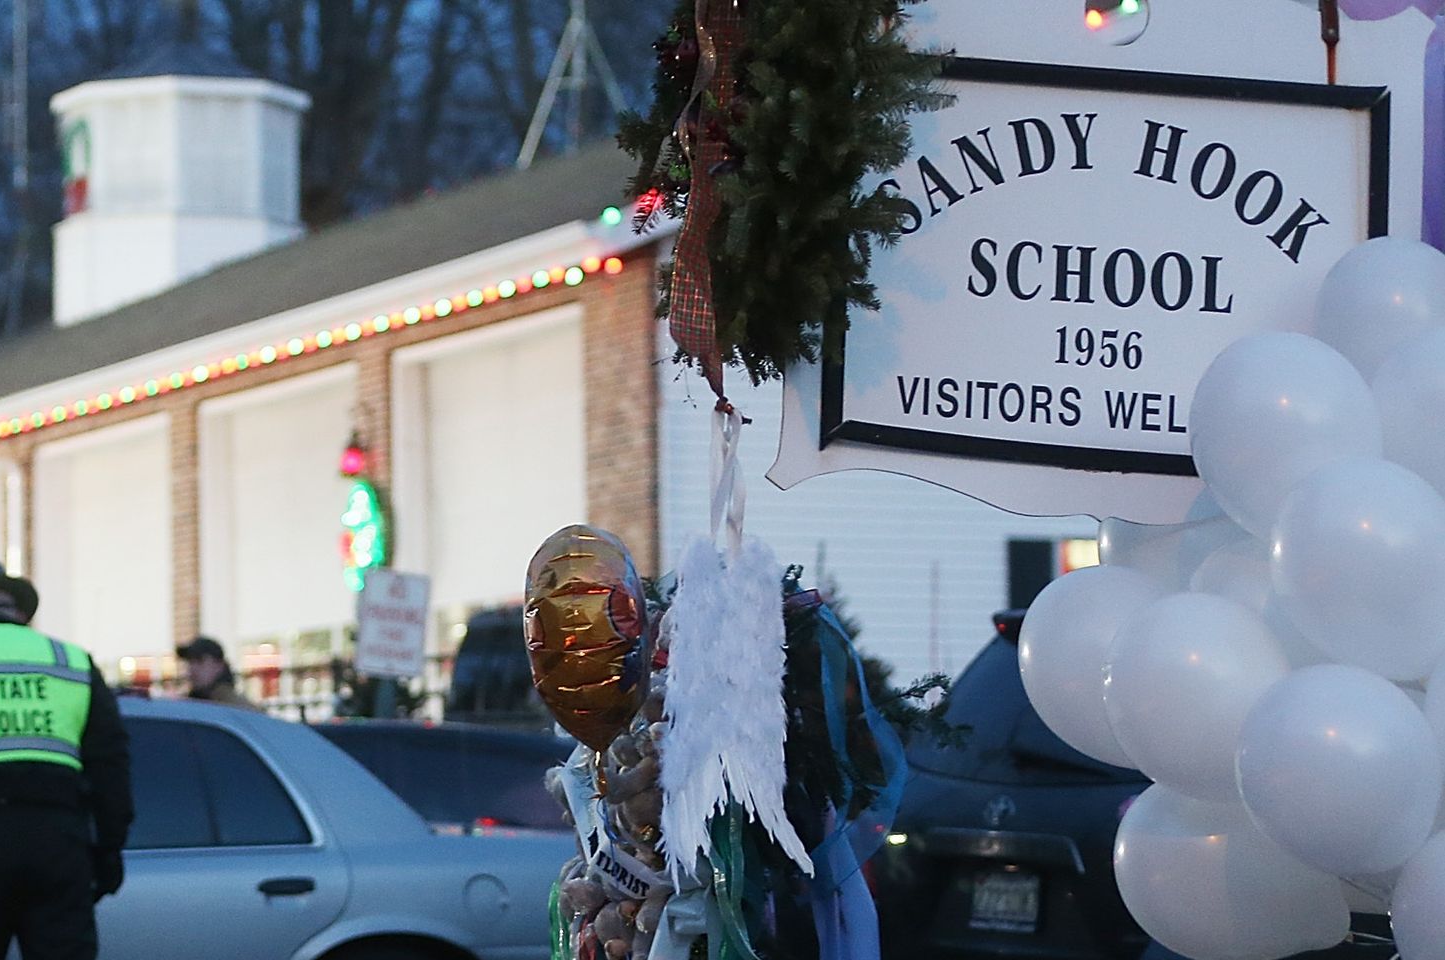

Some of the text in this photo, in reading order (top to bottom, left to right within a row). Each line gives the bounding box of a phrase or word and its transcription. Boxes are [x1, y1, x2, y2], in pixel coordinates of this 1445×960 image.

[1133, 119, 1330, 264] HOOK
[967, 237, 1235, 315] SCHOOL
[1054, 326, 1144, 370] 1956
[897, 375, 1082, 428] VISITORS
